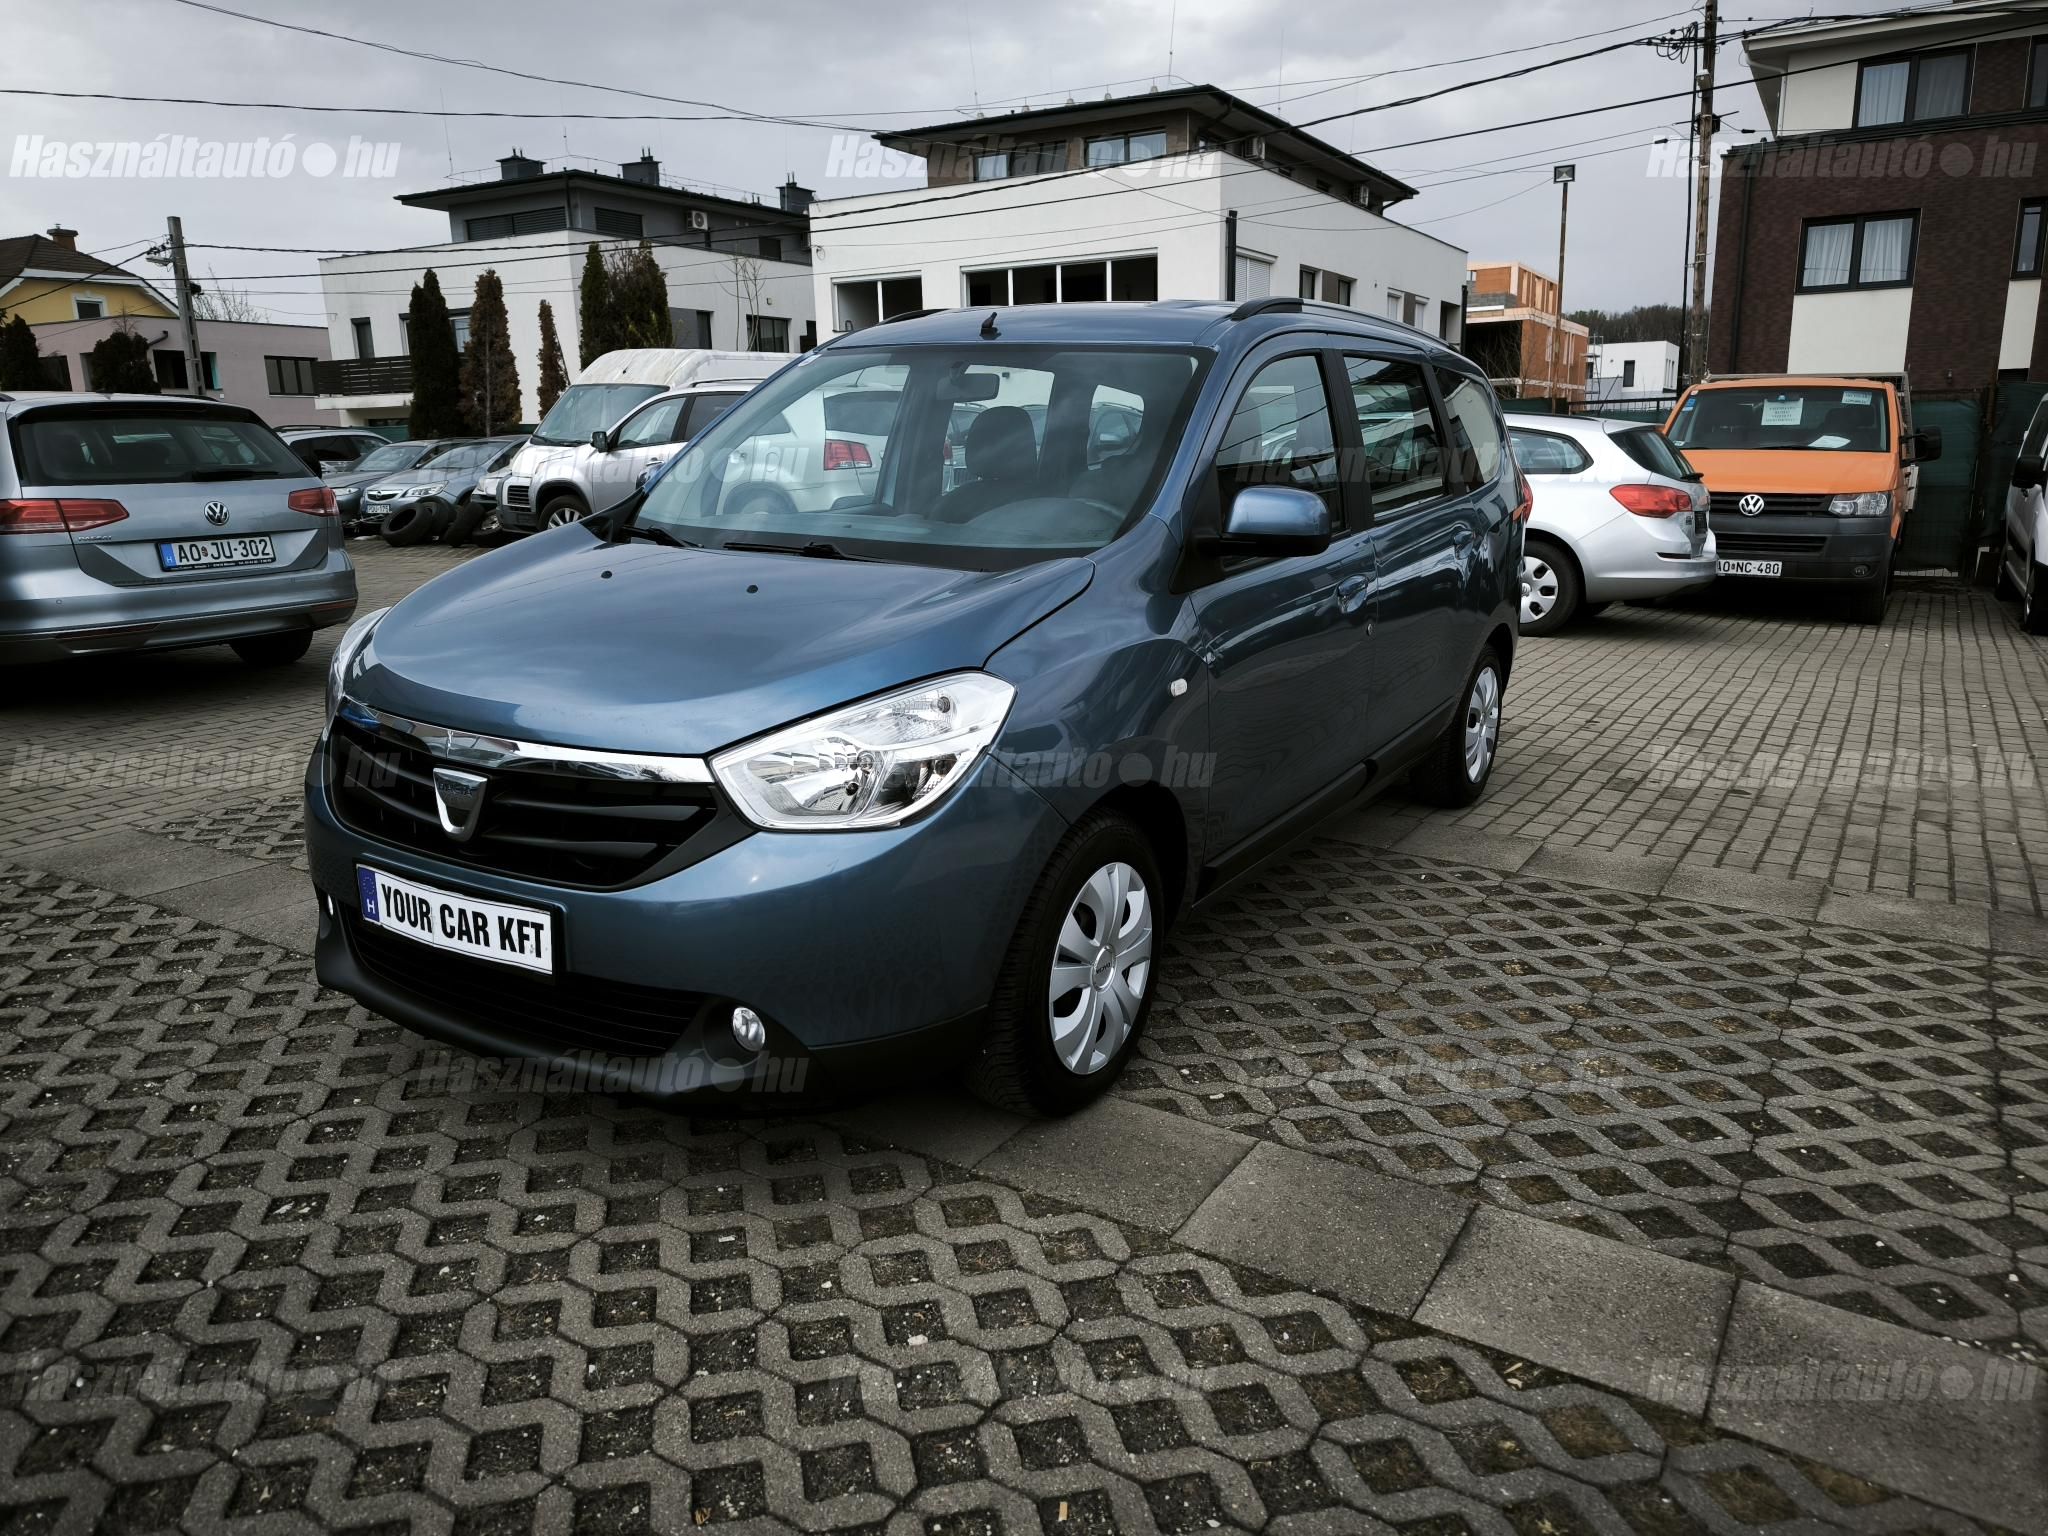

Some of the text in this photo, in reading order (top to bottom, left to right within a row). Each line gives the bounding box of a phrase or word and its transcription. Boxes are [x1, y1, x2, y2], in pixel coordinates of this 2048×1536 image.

[381, 883, 544, 959] YOUR CAR KFT
